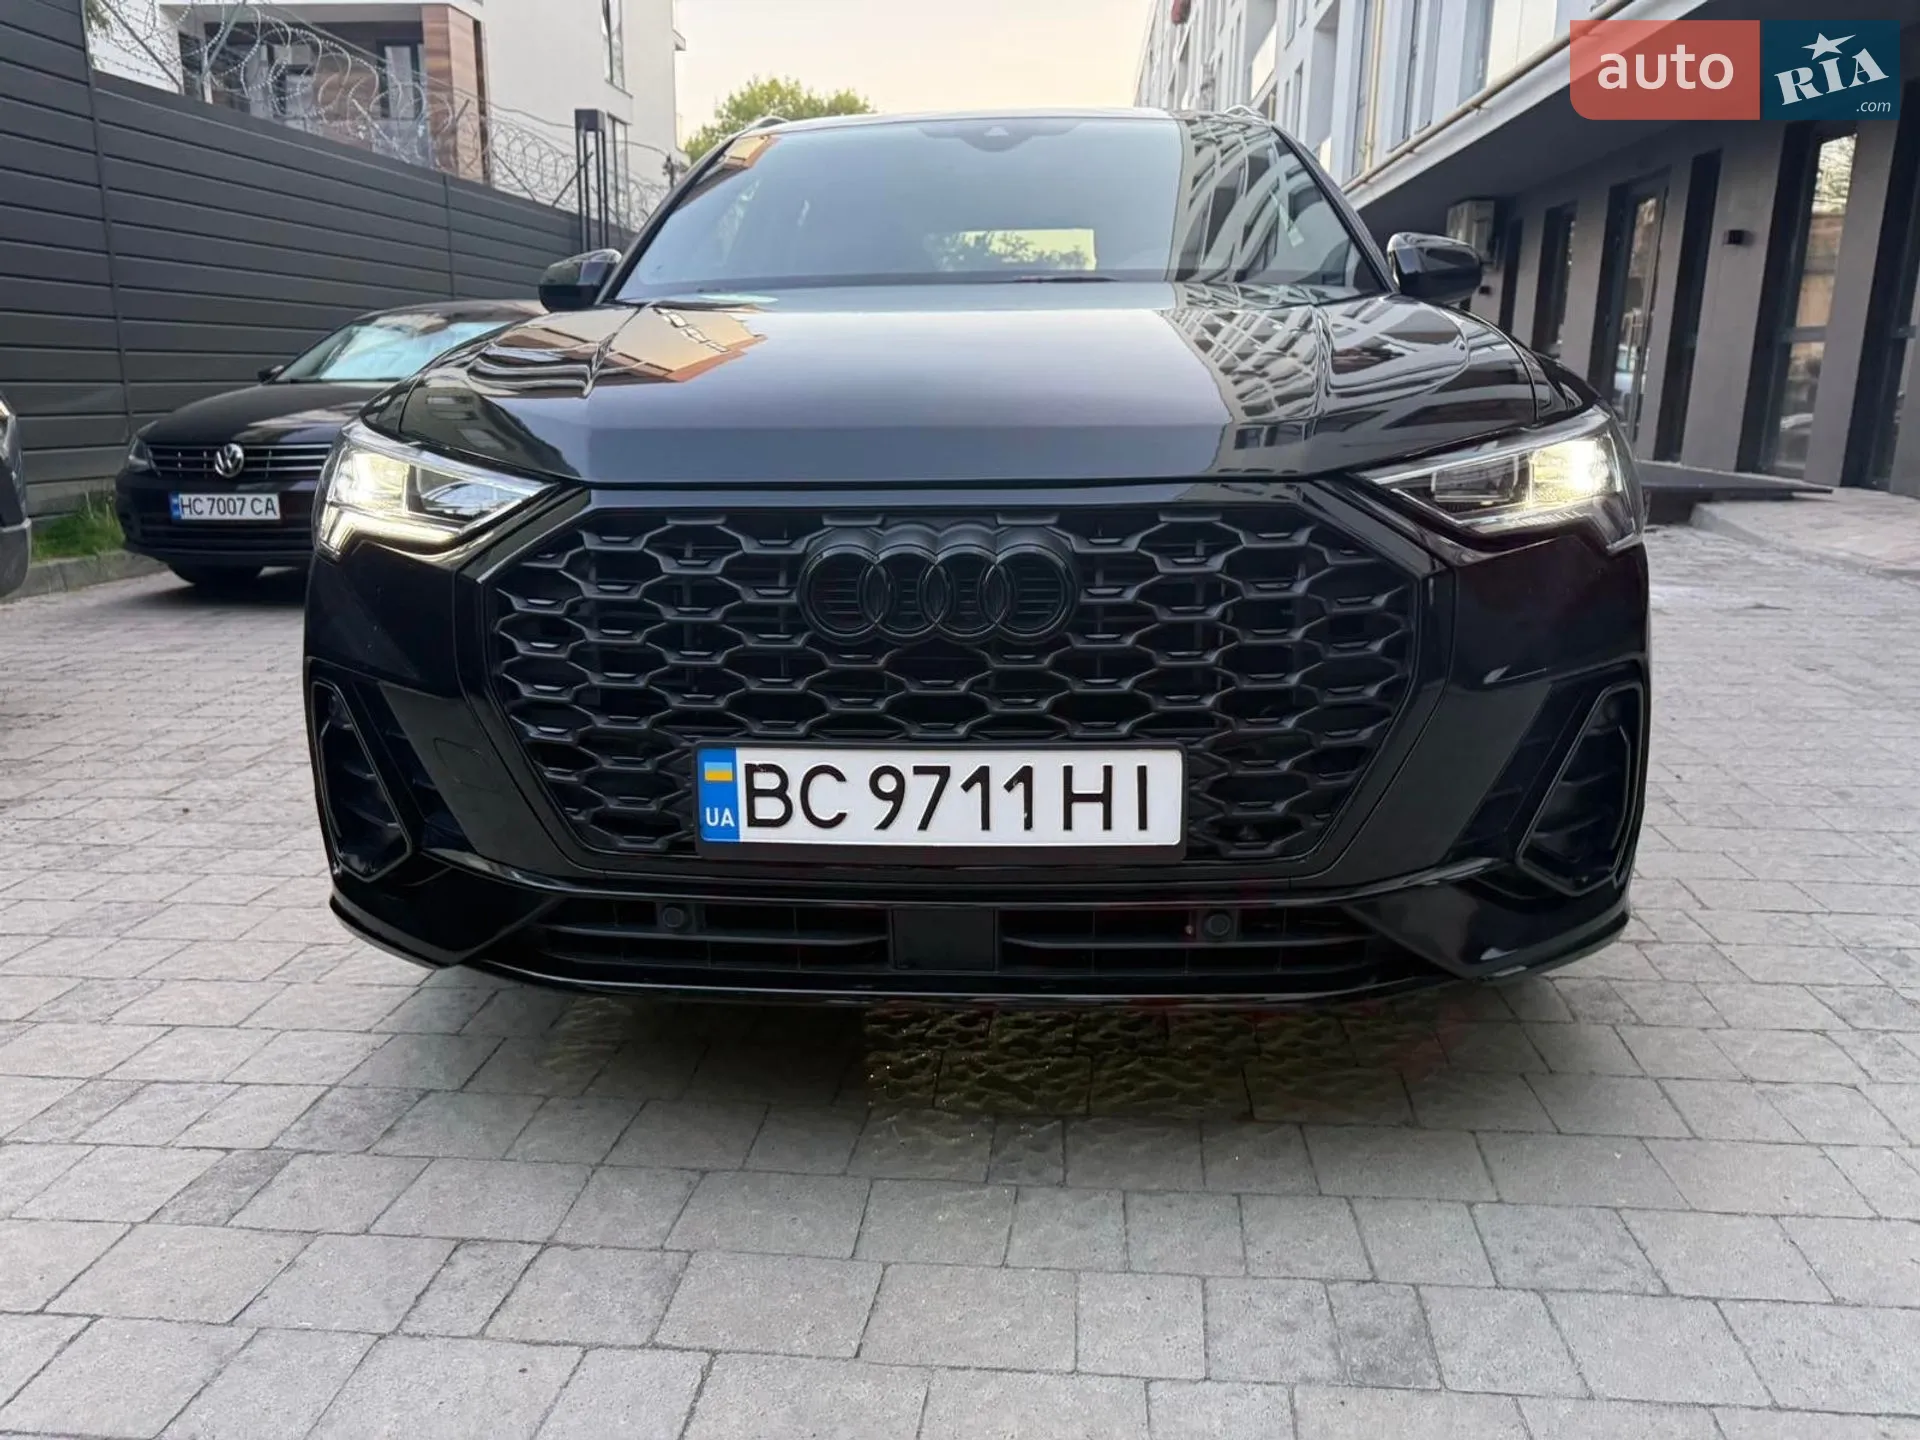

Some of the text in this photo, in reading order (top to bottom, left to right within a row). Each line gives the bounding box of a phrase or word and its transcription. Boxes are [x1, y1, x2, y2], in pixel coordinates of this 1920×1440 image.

[180, 498, 277, 516] HC 7007 CA
[744, 763, 1149, 832] BC 9711 HI
[705, 807, 735, 828] UA
